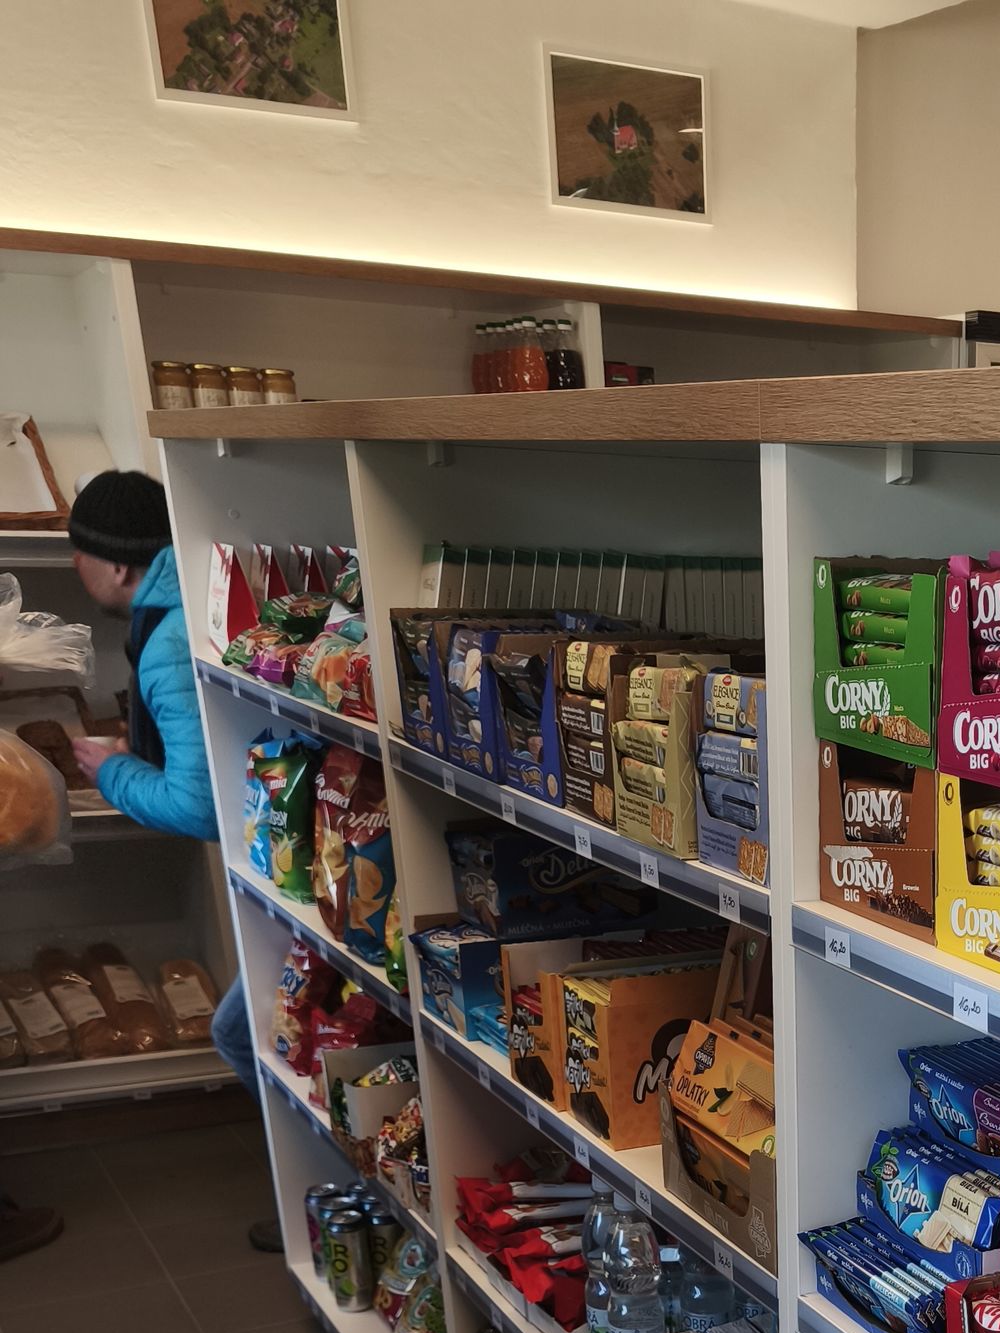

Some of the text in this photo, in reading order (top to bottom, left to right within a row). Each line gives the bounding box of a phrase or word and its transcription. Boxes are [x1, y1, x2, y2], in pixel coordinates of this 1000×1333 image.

[629, 678, 653, 689] ELEGANCE
[713, 685, 740, 700] ELEGANCE
[826, 674, 883, 715] CORNY
[840, 716, 856, 729] BIG
[970, 753, 989, 769] BIG
[844, 789, 895, 827] ORNY
[831, 857, 887, 892] CORNY
[844, 890, 859, 902] BIG
[965, 939, 984, 953] BIG
[955, 1000, 981, 1017] 16,20
[676, 1074, 710, 1107] OPLATKY
[931, 1098, 968, 1128] Orion
[890, 1180, 927, 1211] Orion
[960, 1180, 977, 1194] BIELA
[952, 1197, 969, 1215] BÍLÁ
[683, 1316, 715, 1333] OBRÁ
